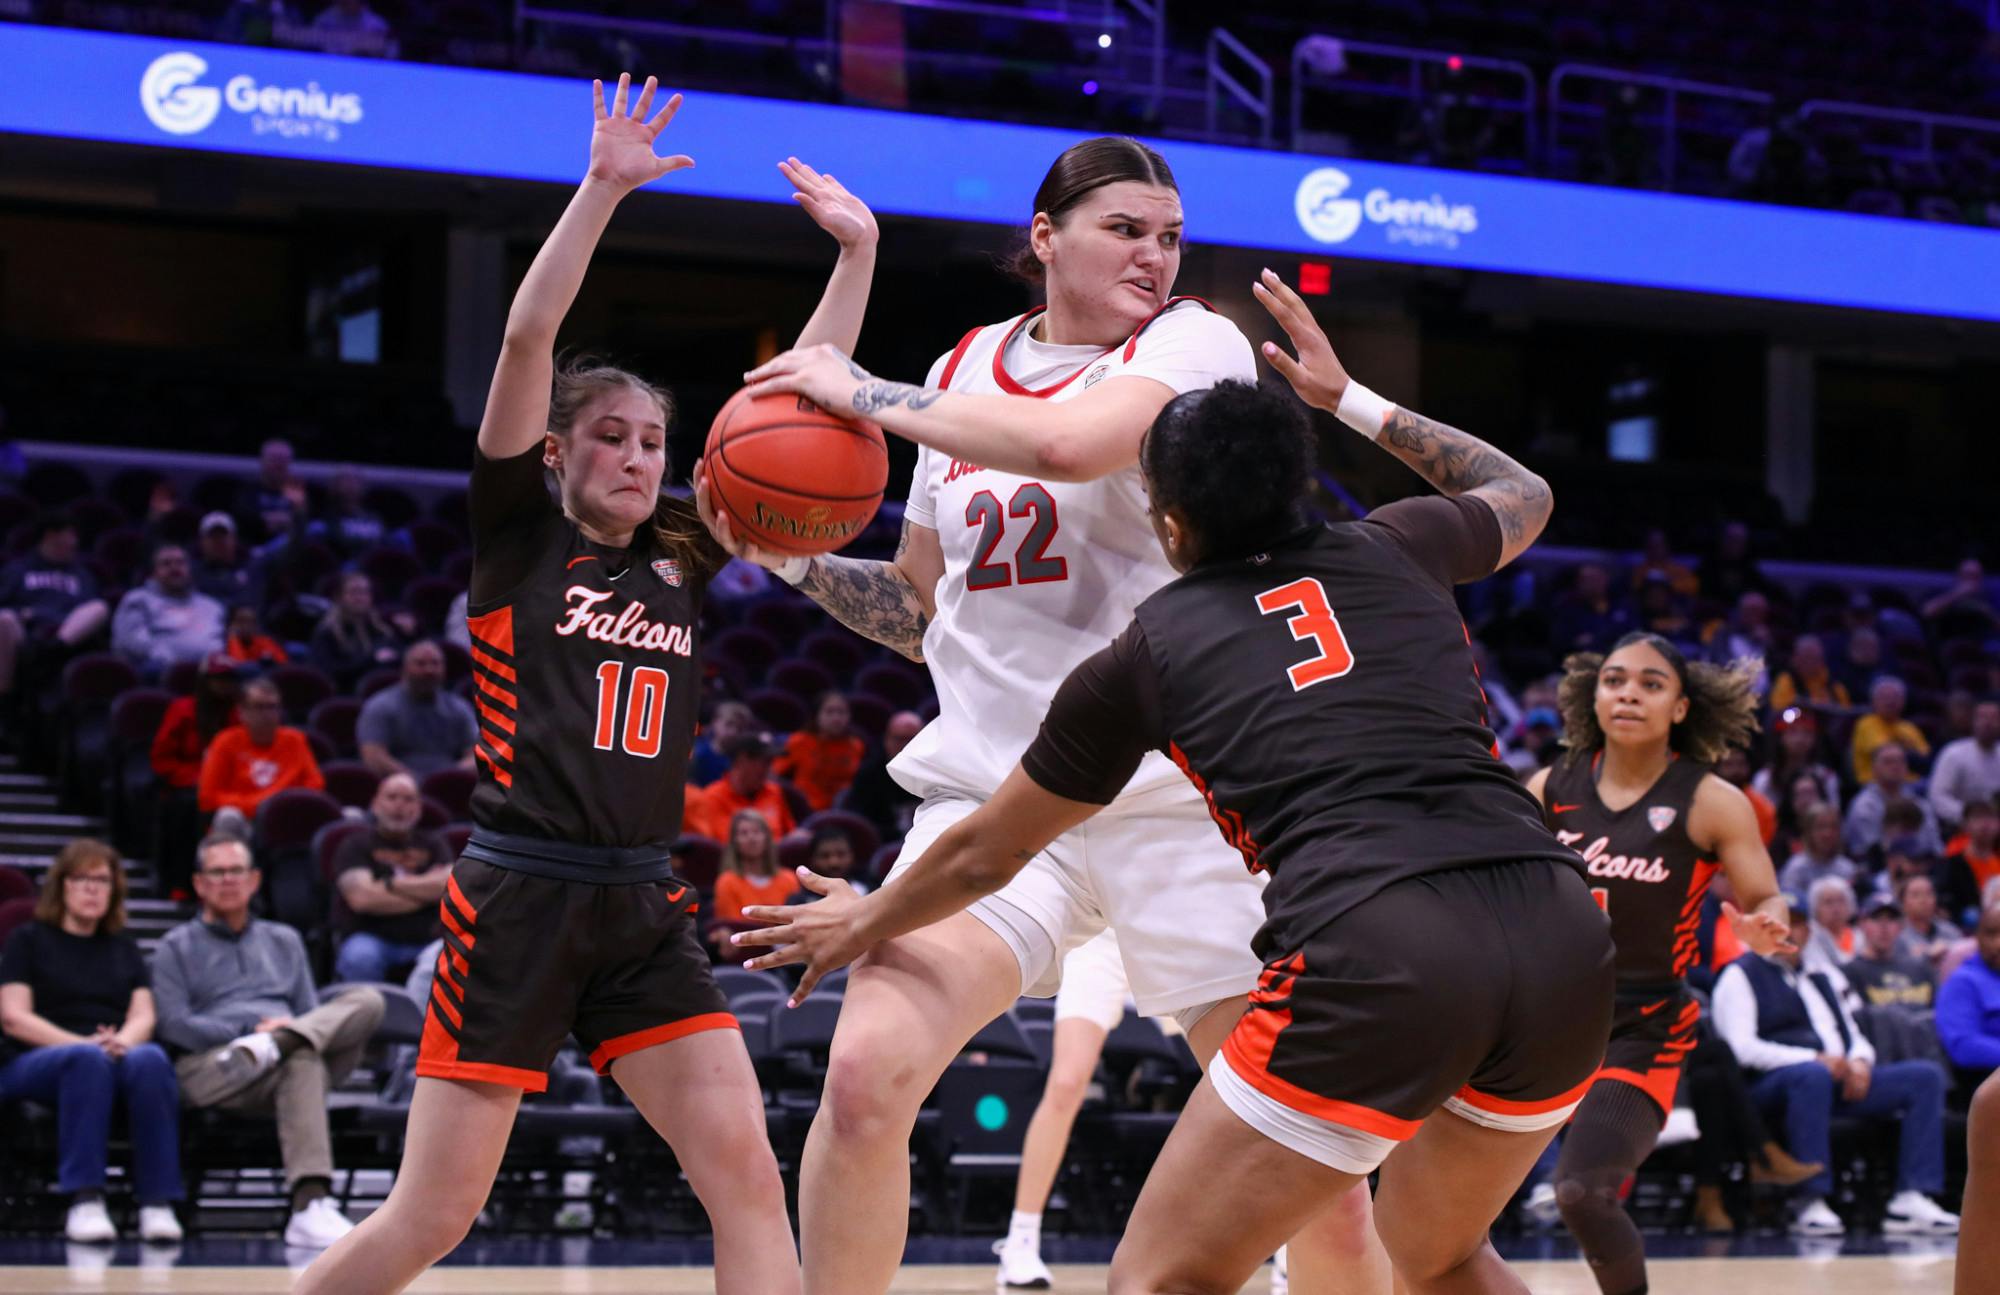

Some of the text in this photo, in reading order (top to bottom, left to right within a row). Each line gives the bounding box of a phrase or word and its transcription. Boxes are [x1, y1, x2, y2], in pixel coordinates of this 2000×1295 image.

[225, 74, 363, 124] Genius
[1364, 187, 1478, 233] Genius
[965, 482, 1068, 592] 22
[555, 585, 692, 657] Falcons
[1254, 576, 1355, 693] 3
[593, 660, 670, 759] 10
